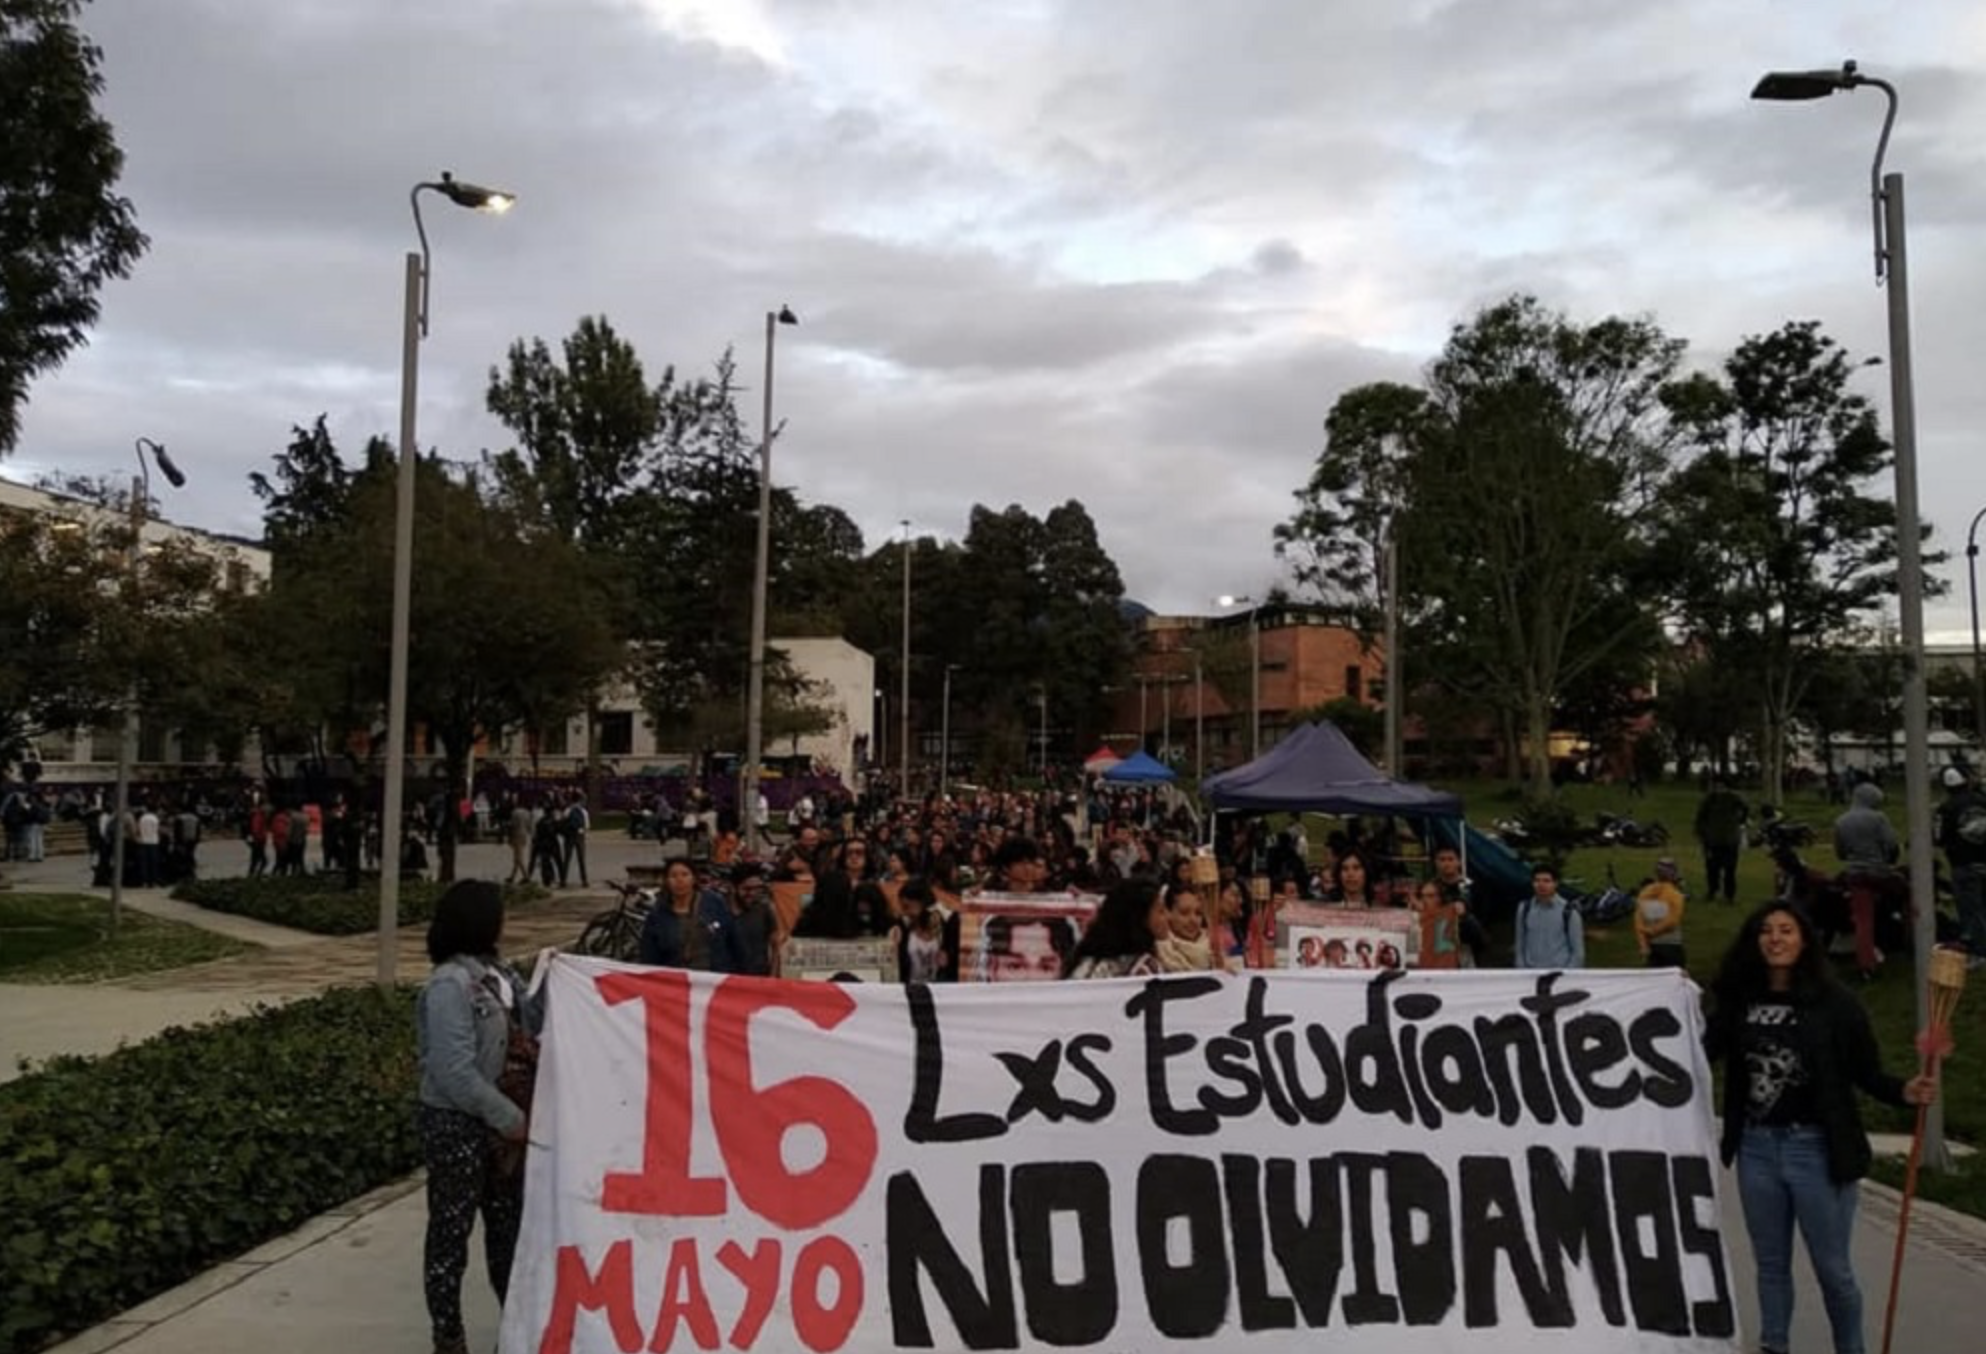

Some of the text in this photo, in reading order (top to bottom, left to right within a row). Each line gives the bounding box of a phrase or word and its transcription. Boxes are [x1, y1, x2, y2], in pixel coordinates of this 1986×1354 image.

[594, 971, 878, 1230] 16
[904, 972, 1694, 1142] Lxs Estudiantes
[540, 1235, 864, 1354] MAYO
[886, 1146, 1735, 1349] NO OLVIDAMOS
